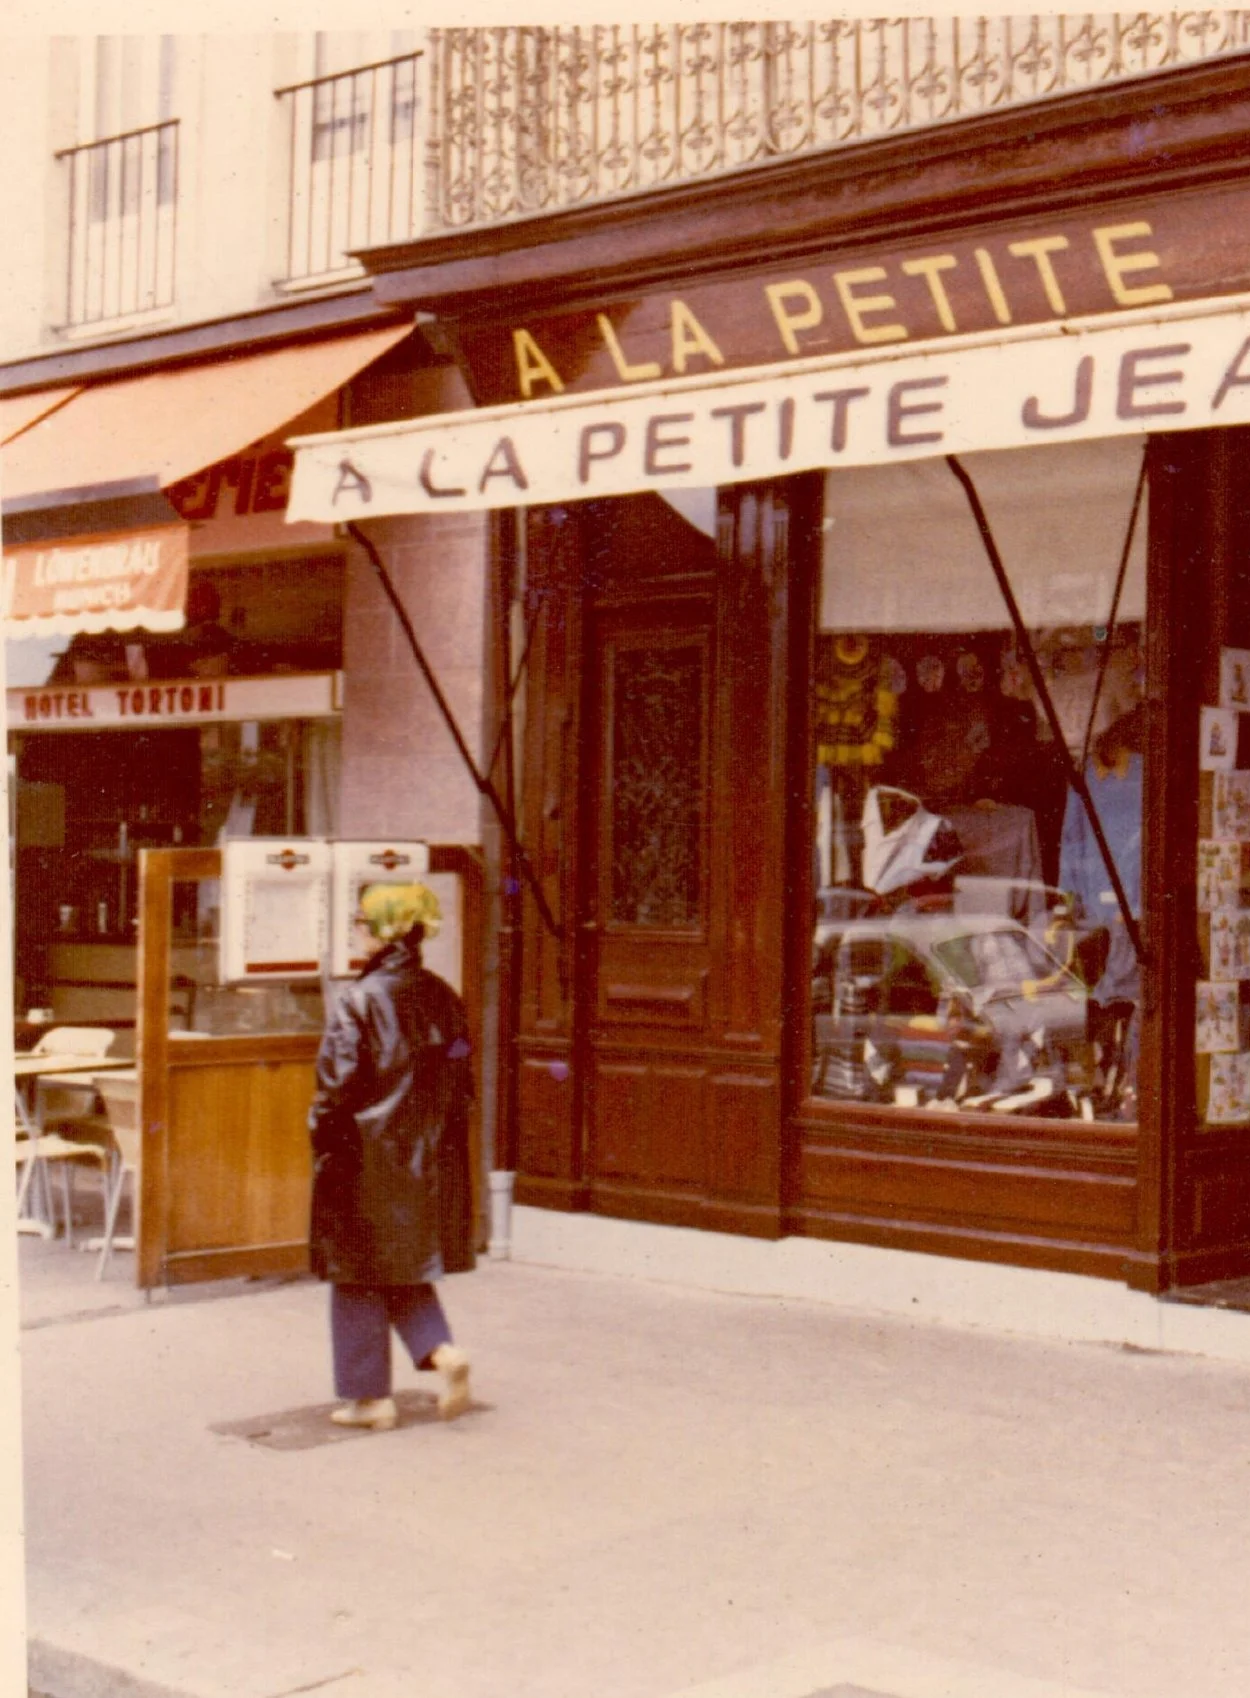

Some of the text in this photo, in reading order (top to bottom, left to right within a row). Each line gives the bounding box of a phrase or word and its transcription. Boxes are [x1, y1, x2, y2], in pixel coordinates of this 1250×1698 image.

[513, 330, 565, 397] A
[598, 298, 724, 382] LA
[765, 221, 1173, 354] PETITE
[330, 457, 373, 506] A
[417, 436, 529, 499] LA
[577, 376, 950, 485] PETITE
[24, 684, 226, 720] HOTEL TORTONI
